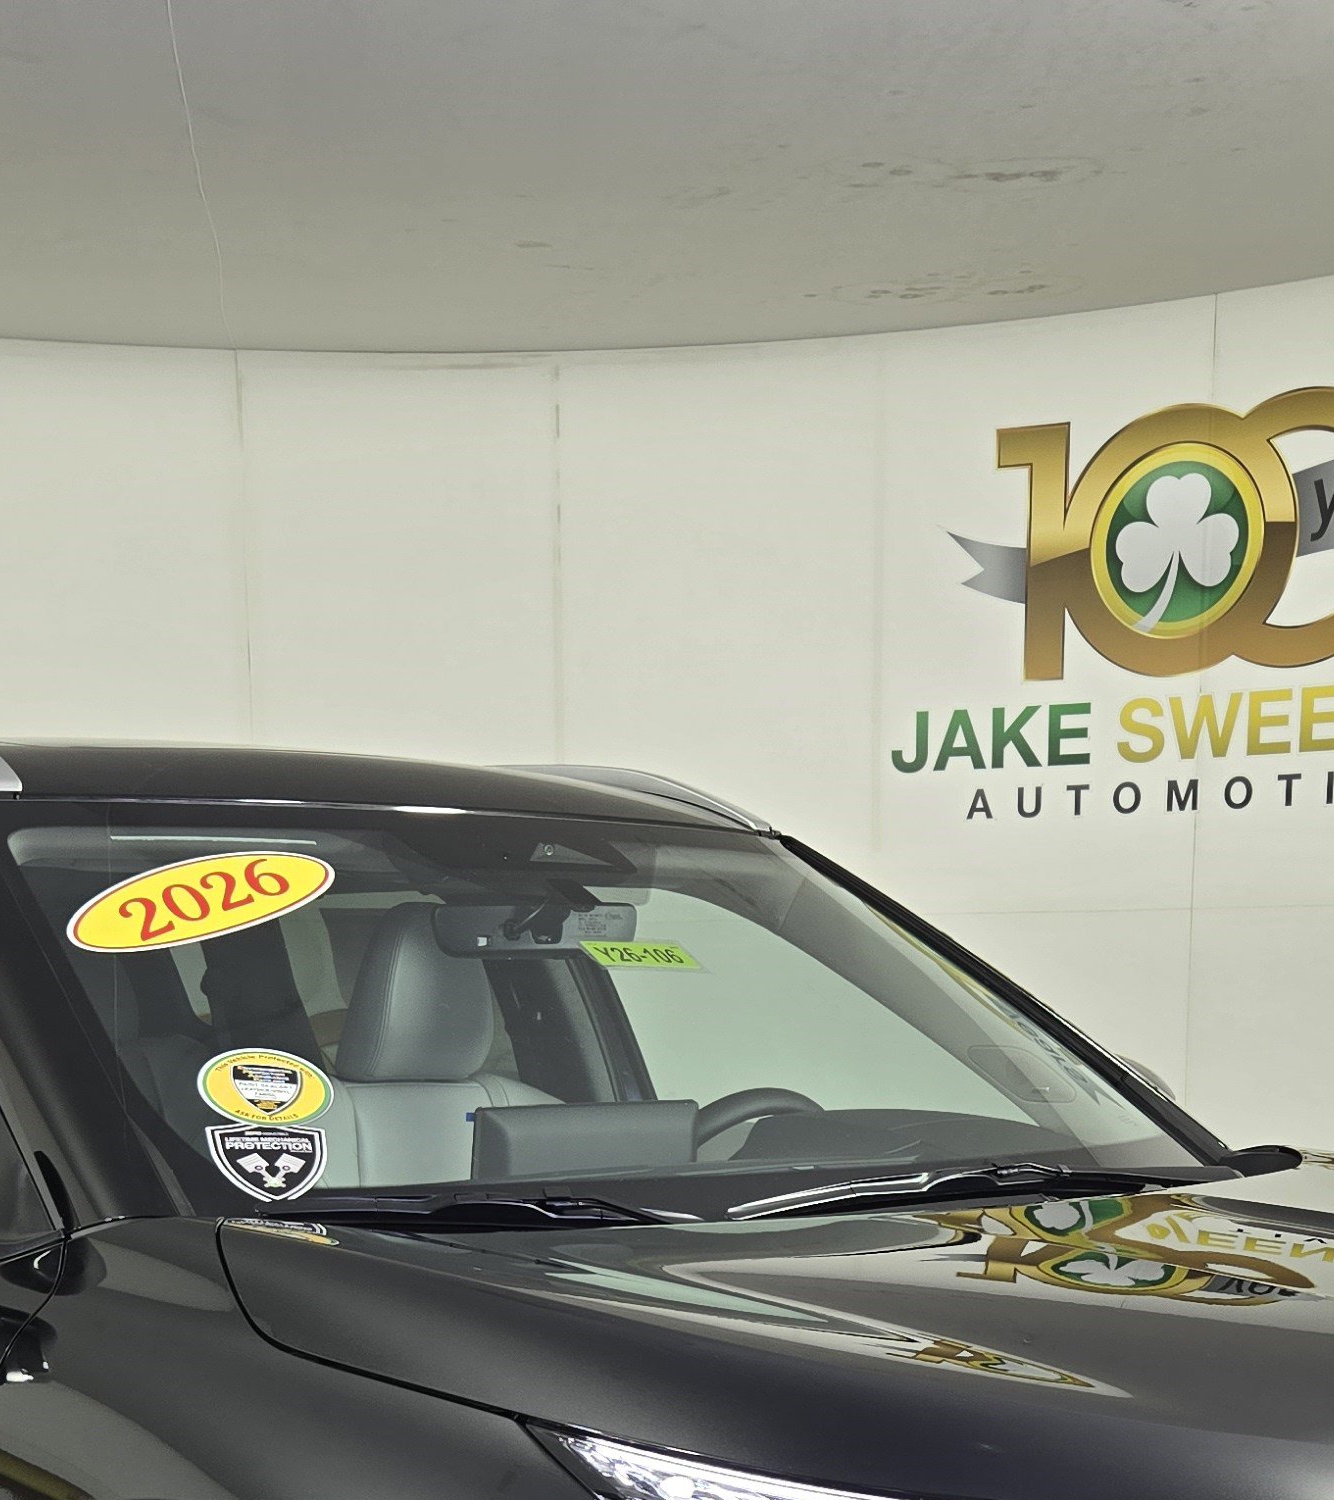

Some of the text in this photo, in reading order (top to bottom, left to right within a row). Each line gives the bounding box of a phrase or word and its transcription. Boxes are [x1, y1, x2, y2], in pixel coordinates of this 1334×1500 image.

[891, 702, 1092, 773] JAKE
[117, 858, 291, 942] 2026
[592, 946, 684, 964] Y26-106
[224, 1142, 313, 1151] PROTECTION
